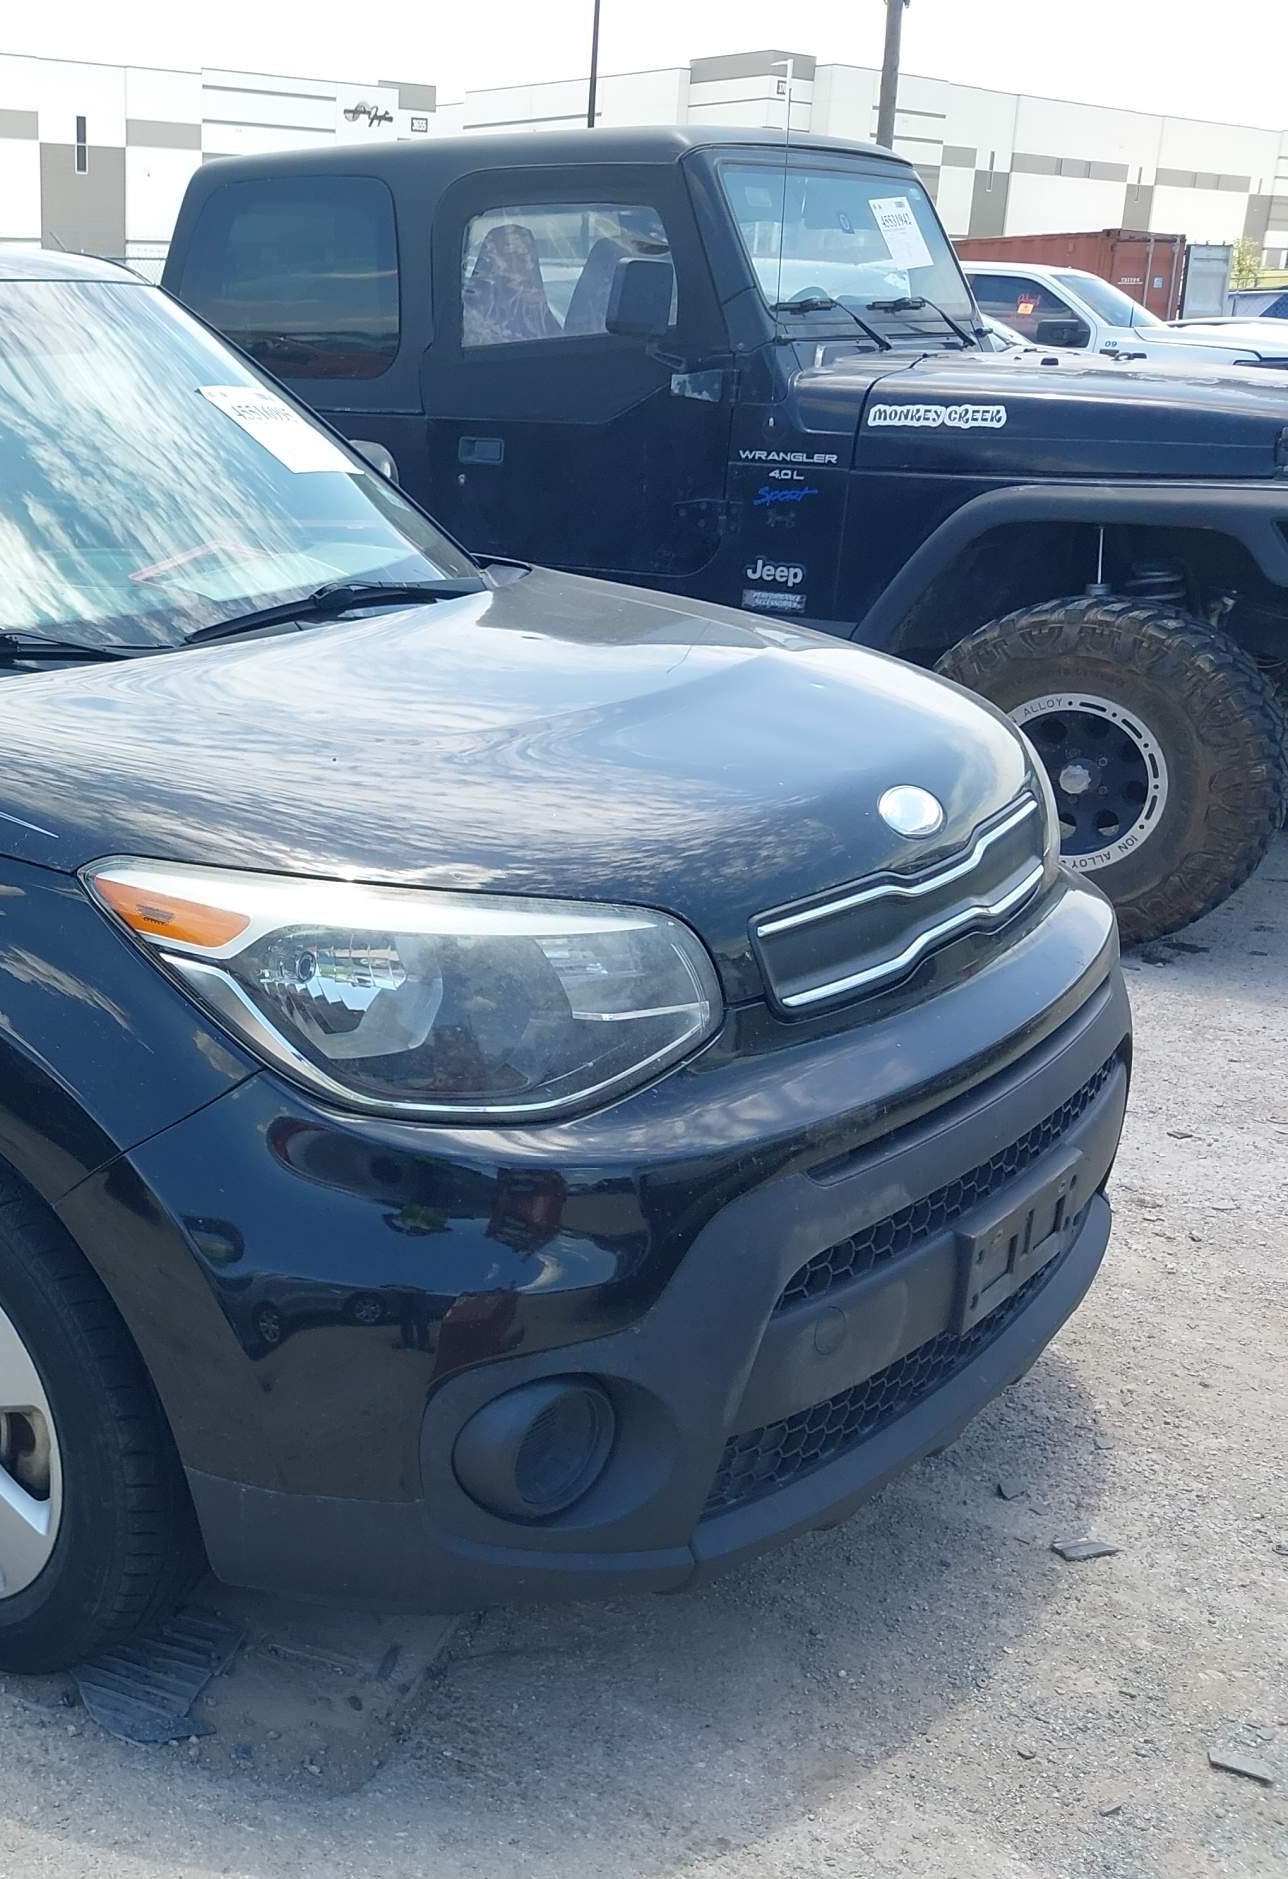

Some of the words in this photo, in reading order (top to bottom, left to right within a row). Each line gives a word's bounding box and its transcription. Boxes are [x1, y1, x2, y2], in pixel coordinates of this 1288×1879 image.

[871, 408, 943, 422] MONKEY
[947, 408, 1003, 424] CREEK
[739, 449, 838, 464] WRANGLER
[746, 559, 803, 587] Jeep
[1023, 698, 1063, 717] ALLOY
[1117, 834, 1139, 853] ION
[1071, 851, 1112, 869] ALLOY
